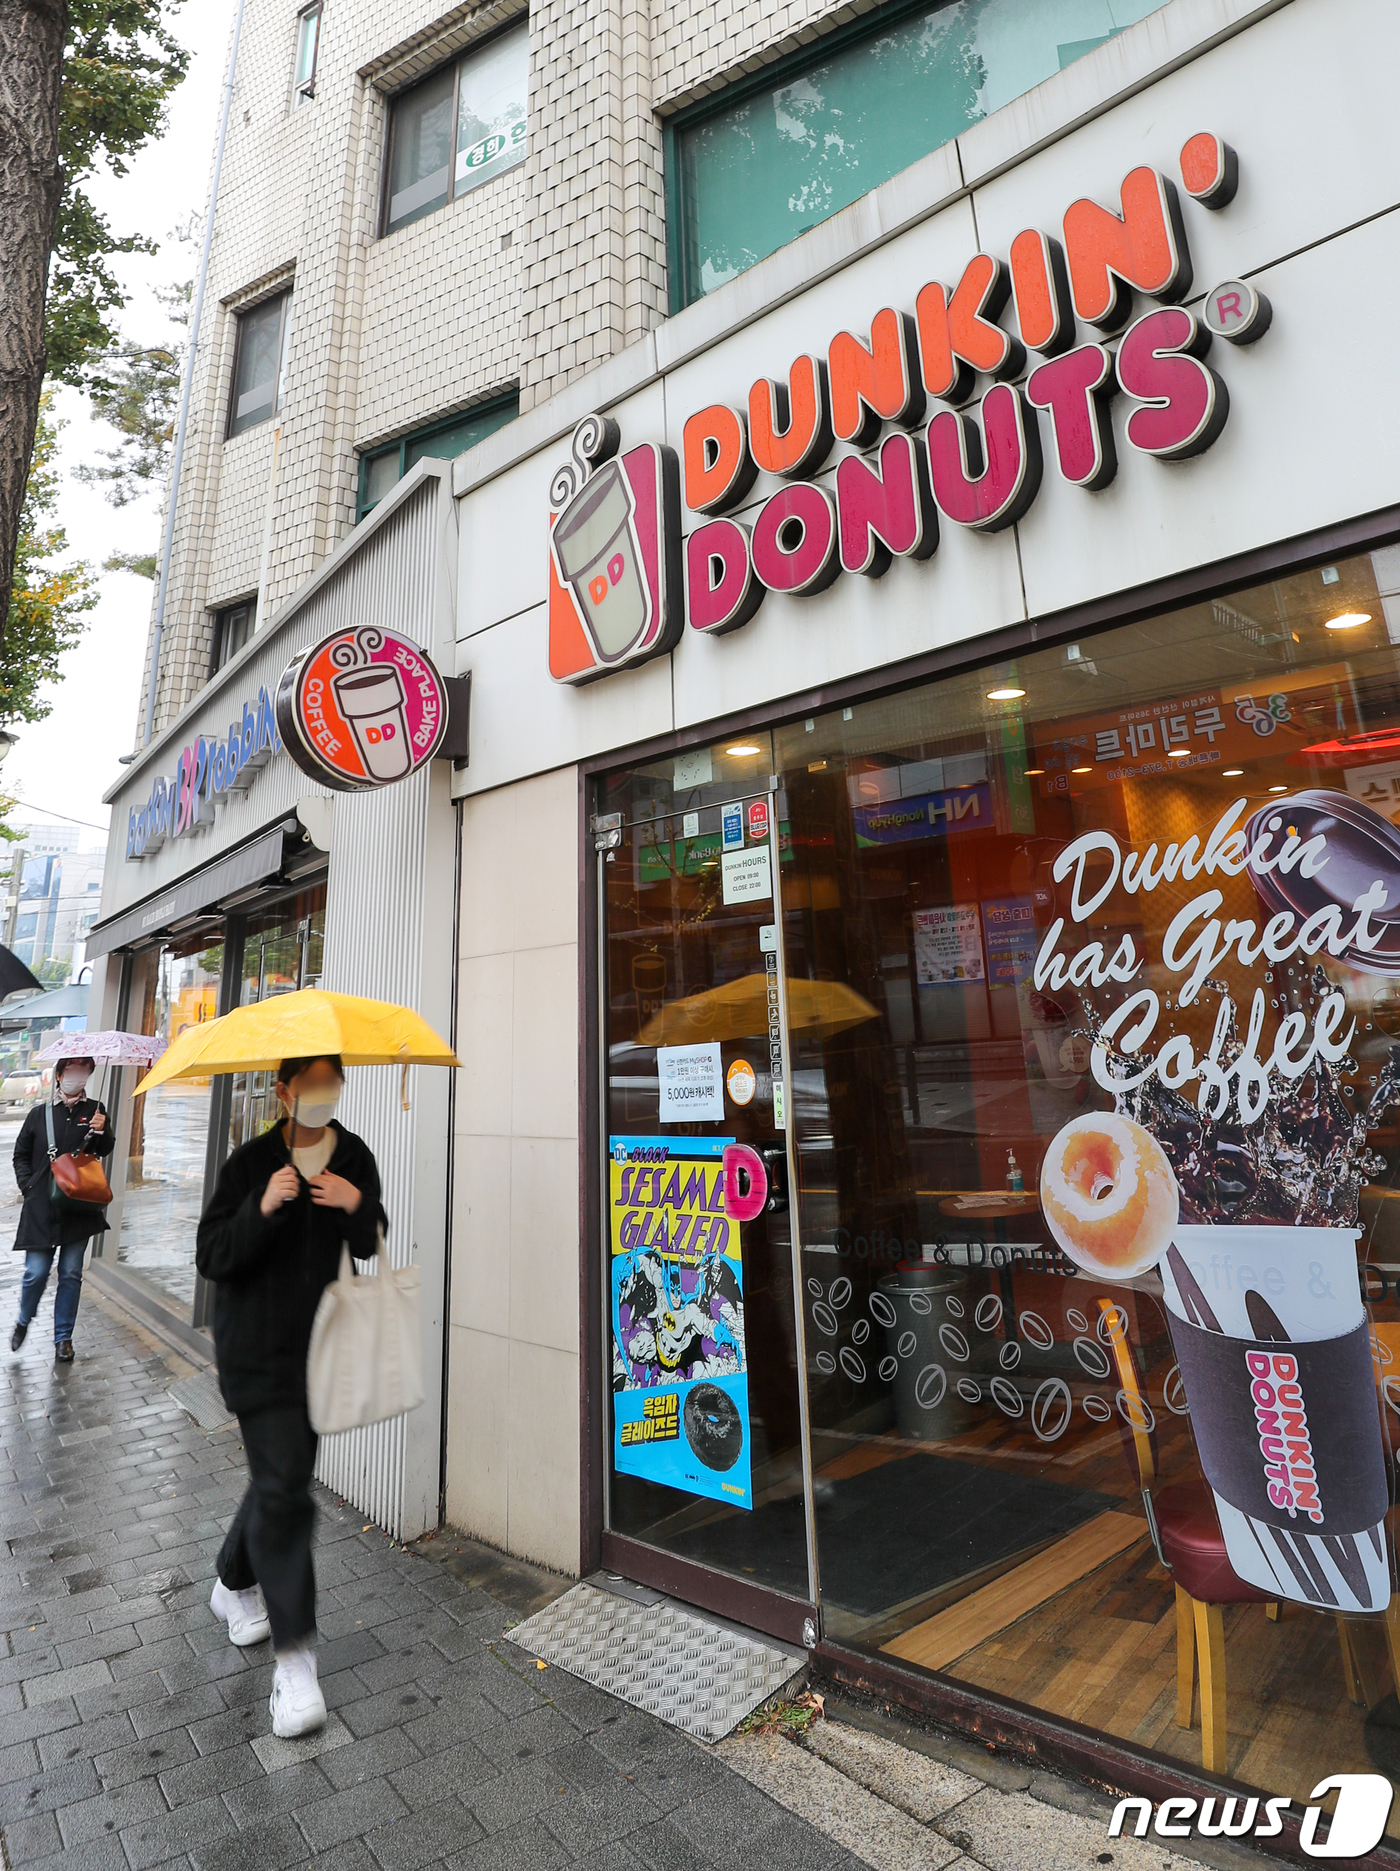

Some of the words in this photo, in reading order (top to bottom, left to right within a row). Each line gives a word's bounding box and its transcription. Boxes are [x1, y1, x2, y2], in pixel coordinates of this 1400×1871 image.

[472, 136, 500, 165] 경희
[683, 129, 1225, 513] DUNKIN'
[686, 305, 1217, 633] DONUTS
[588, 552, 625, 606] DD
[393, 647, 435, 698] PLACE
[306, 678, 342, 757] COFFEE
[365, 723, 396, 744] DD
[413, 700, 437, 748] BAKE
[742, 856, 767, 867] HOURS
[1052, 797, 1331, 922] Dunkin
[1033, 917, 1145, 991] has
[1162, 879, 1389, 1007] Great
[1090, 987, 1357, 1124] Coffee
[615, 1147, 627, 1161] DC
[631, 1146, 669, 1164] BLACK
[722, 1143, 768, 1222] D
[620, 1208, 730, 1256] GLAZED
[834, 1227, 919, 1262] Coffee
[966, 1235, 1079, 1277] Donuts
[620, 1415, 679, 1445] 글레이즈드
[643, 1393, 679, 1417] 흑임자
[1247, 1352, 1294, 1508] DONUTS
[1272, 1355, 1322, 1522] DUNKIN'
